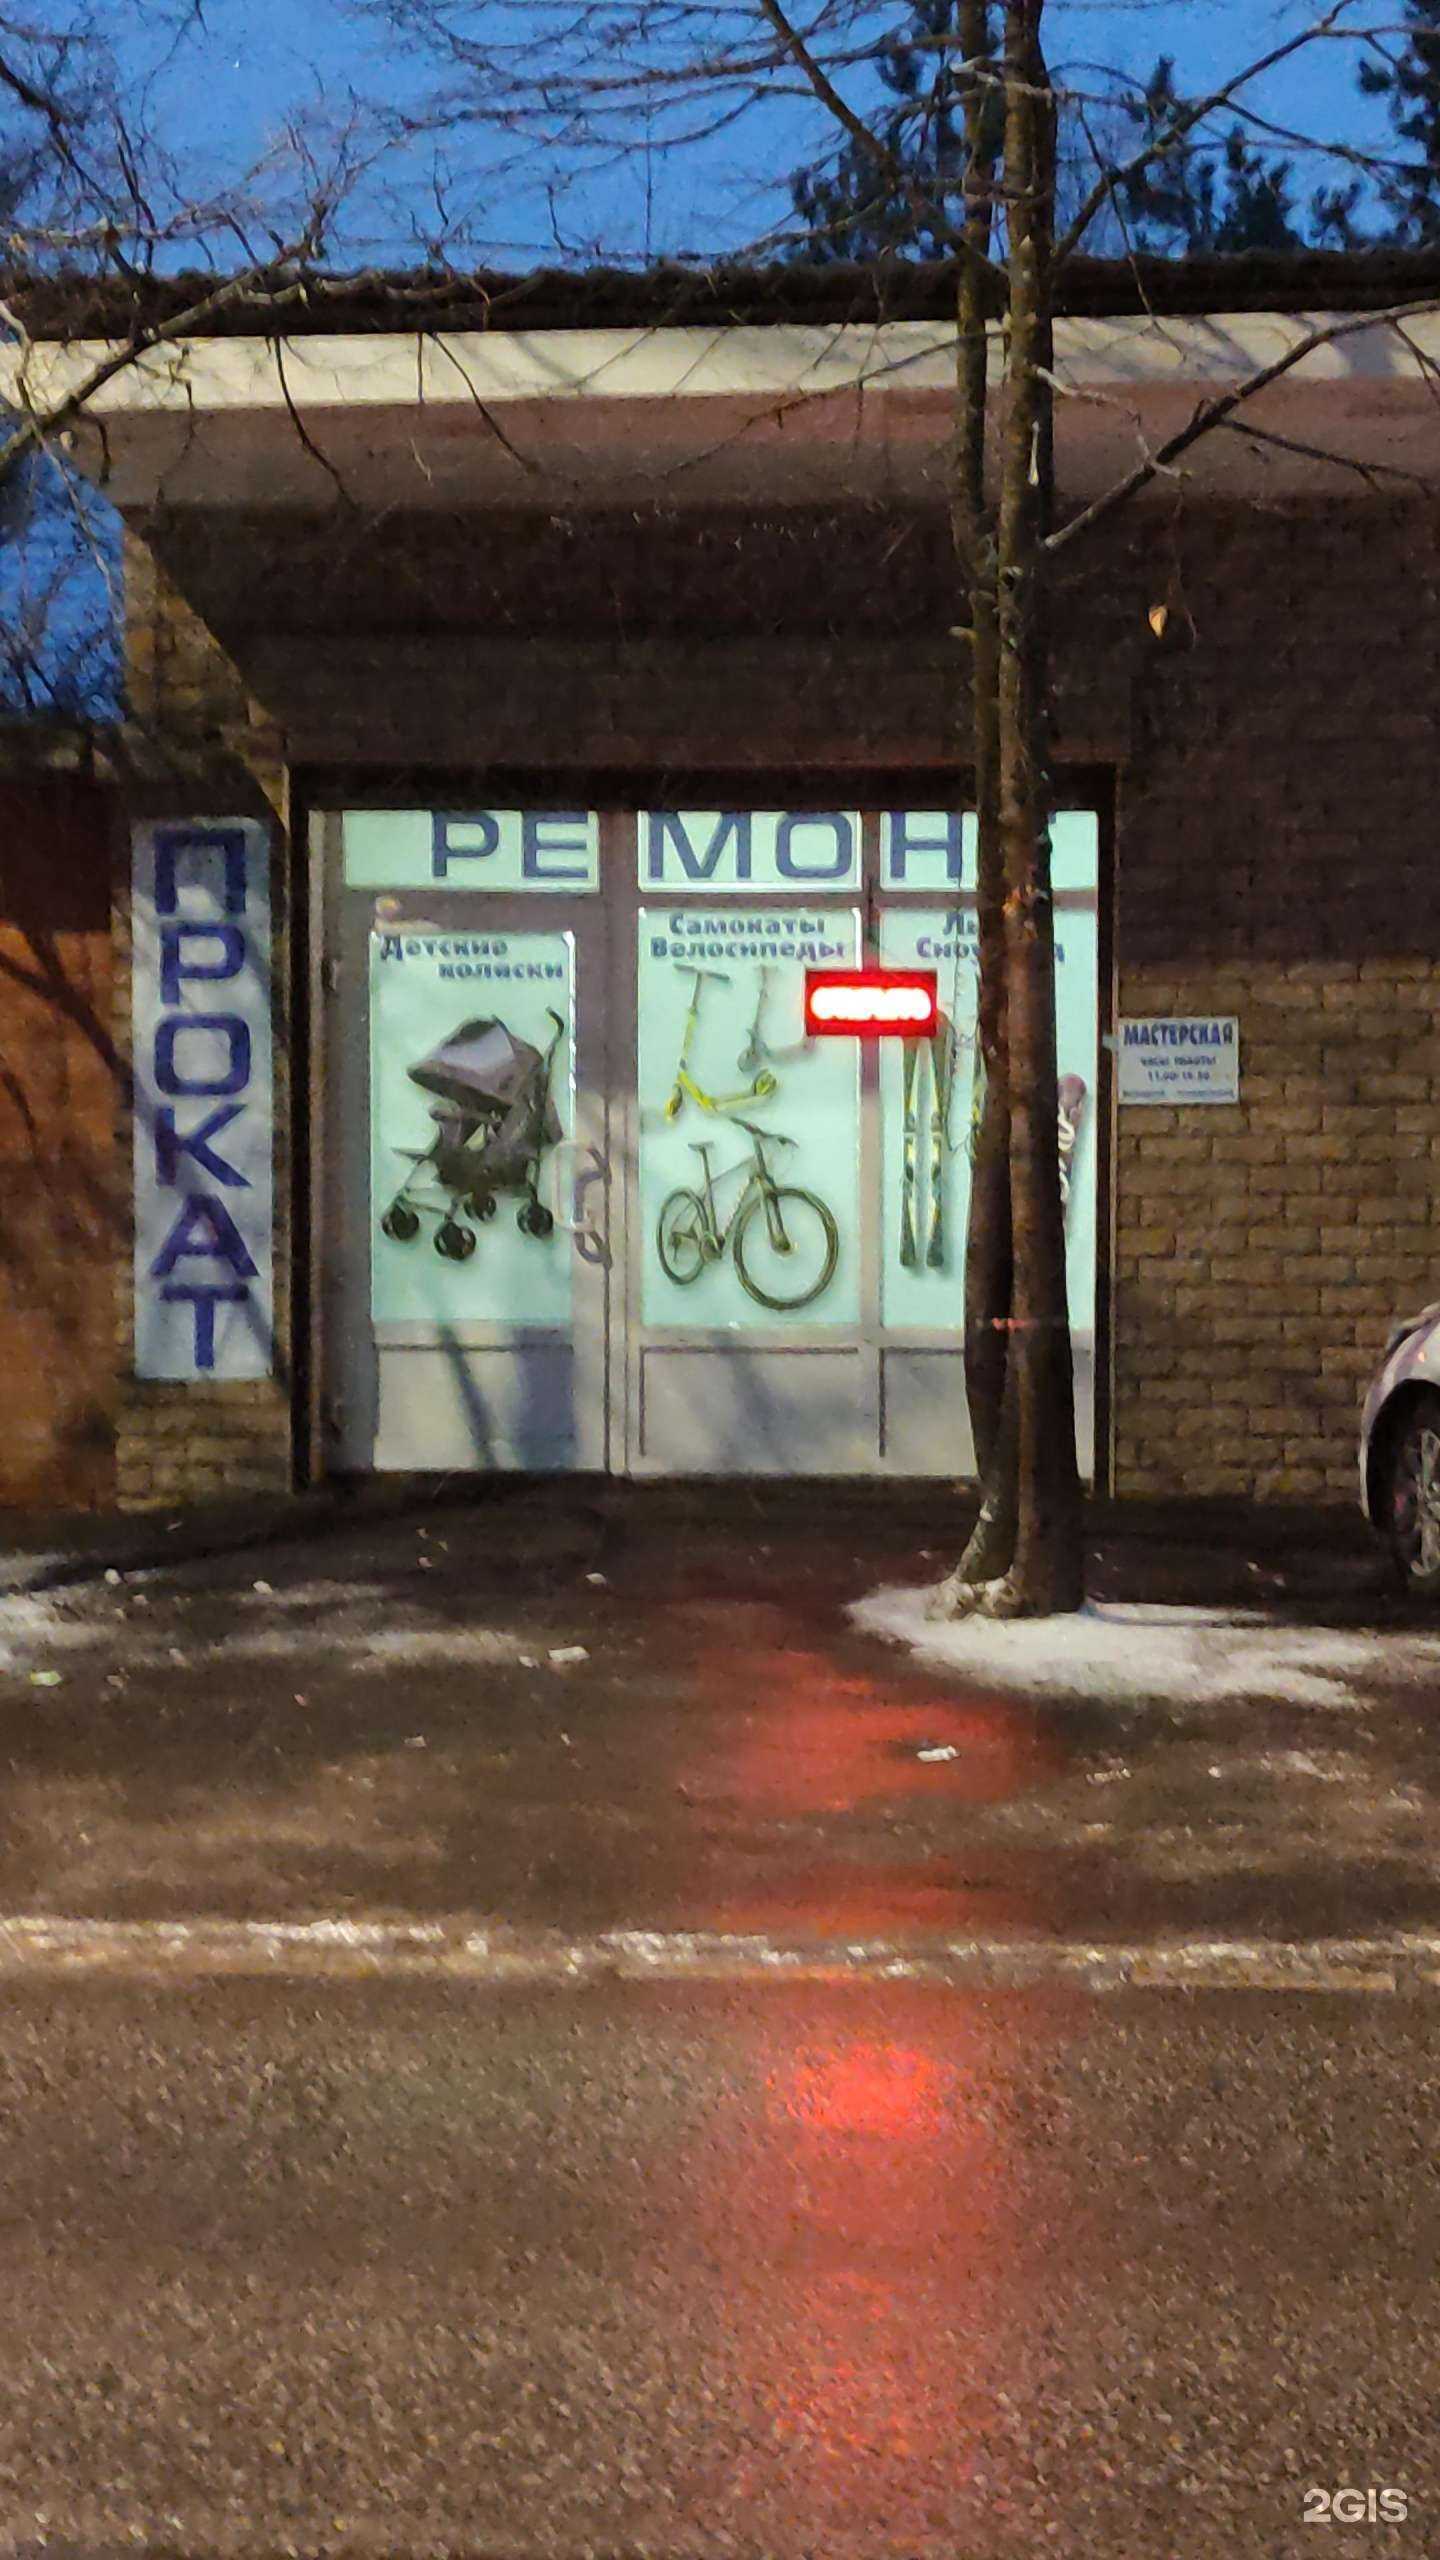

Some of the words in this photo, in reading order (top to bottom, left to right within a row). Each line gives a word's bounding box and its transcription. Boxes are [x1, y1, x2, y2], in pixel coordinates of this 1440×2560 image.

[432, 811, 1056, 879] РЕМОН
[669, 911, 825, 935] Самокаты
[379, 934, 509, 961] Детские
[651, 936, 845, 962] Велосипеды
[437, 963, 563, 979] коляски
[1123, 1022, 1233, 1046] МАСТЕРСКАЯ
[150, 827, 261, 1370] ПРОКАТ
